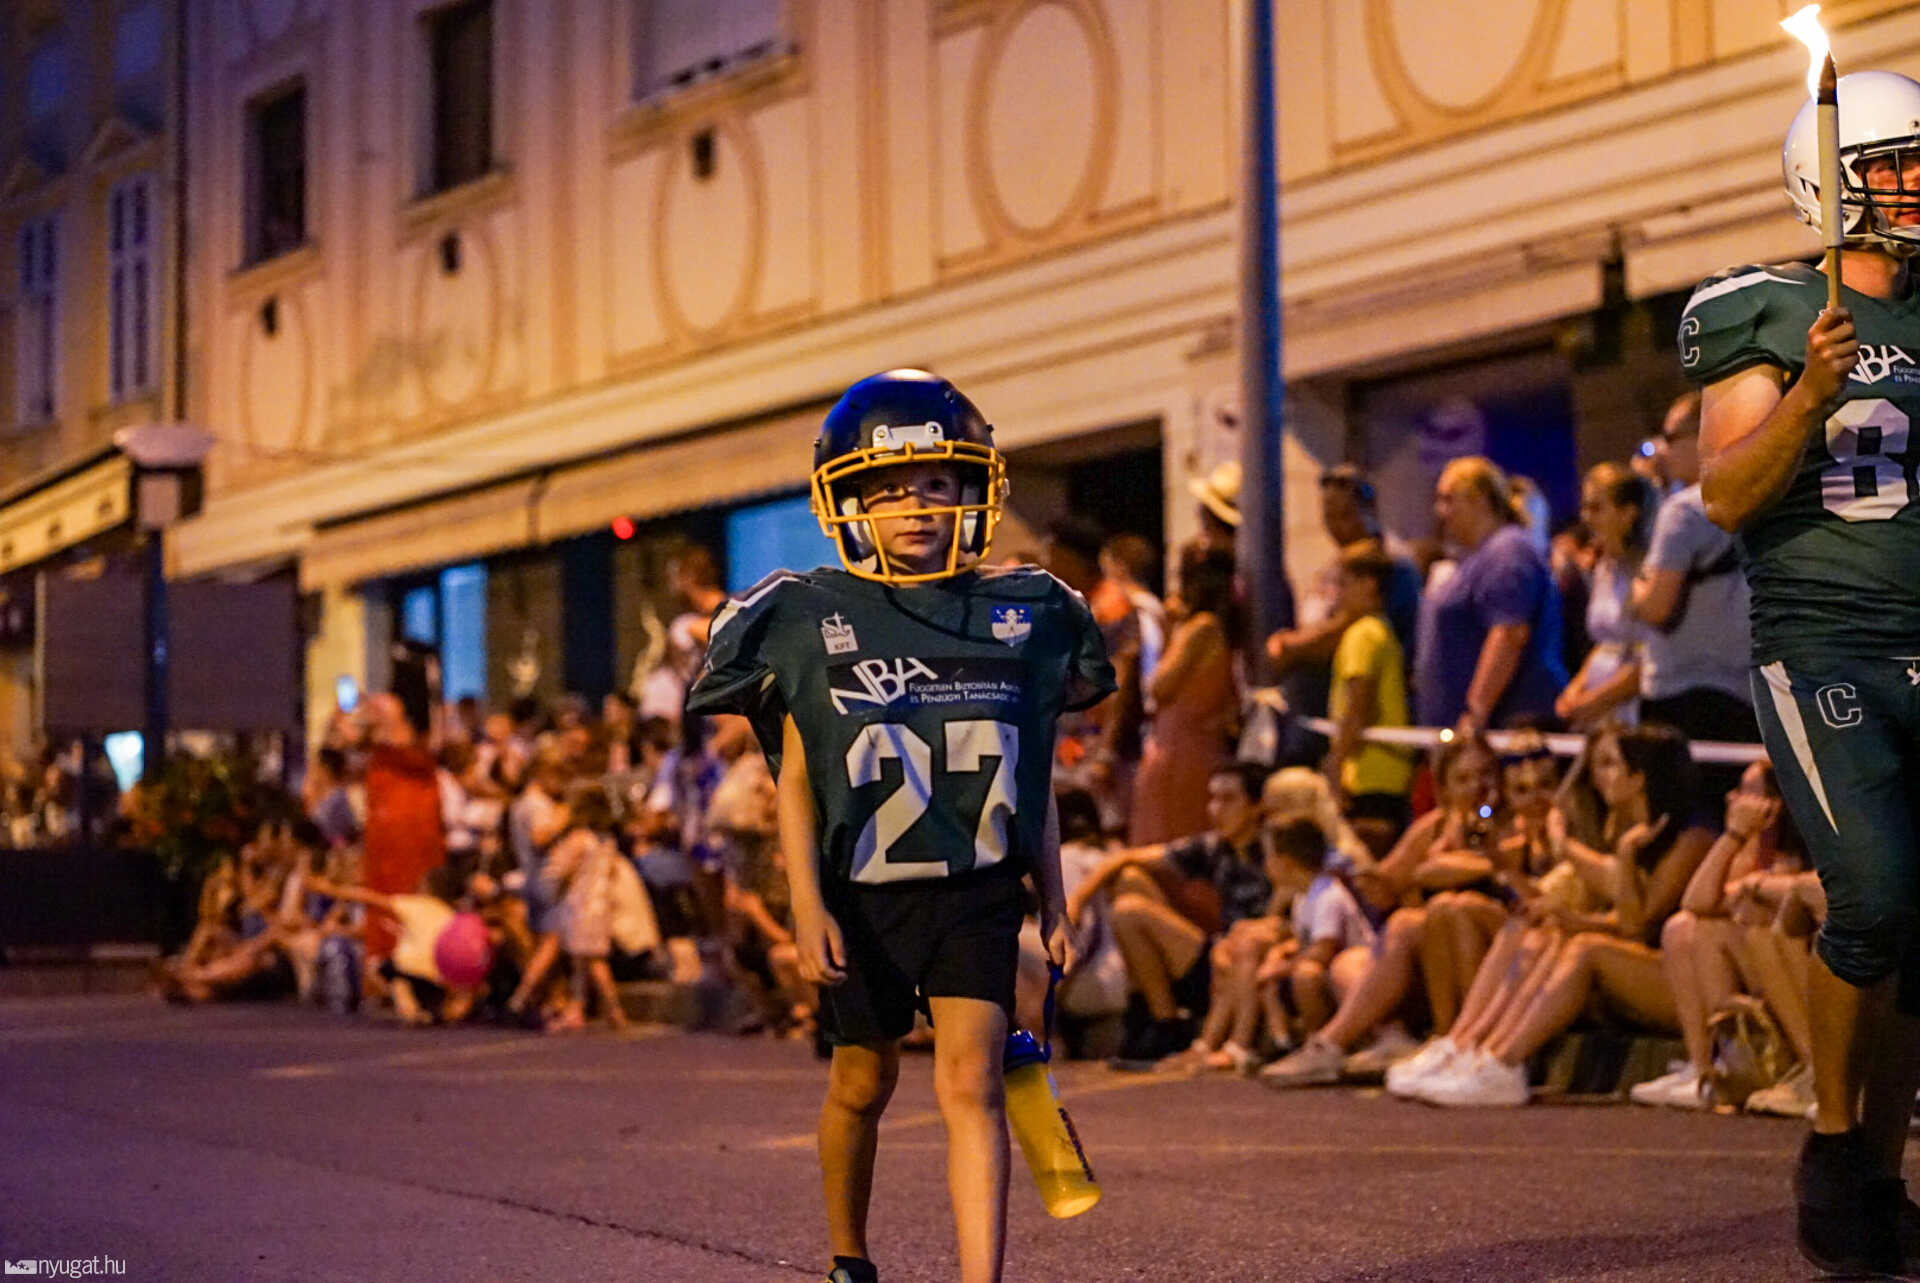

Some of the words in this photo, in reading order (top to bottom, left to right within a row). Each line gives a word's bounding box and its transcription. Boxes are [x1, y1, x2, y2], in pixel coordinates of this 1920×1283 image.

[1677, 317, 1701, 368] C
[1820, 398, 1920, 523] 8
[829, 657, 939, 716] NBA
[1815, 682, 1863, 729] C
[846, 720, 1020, 885] 27
